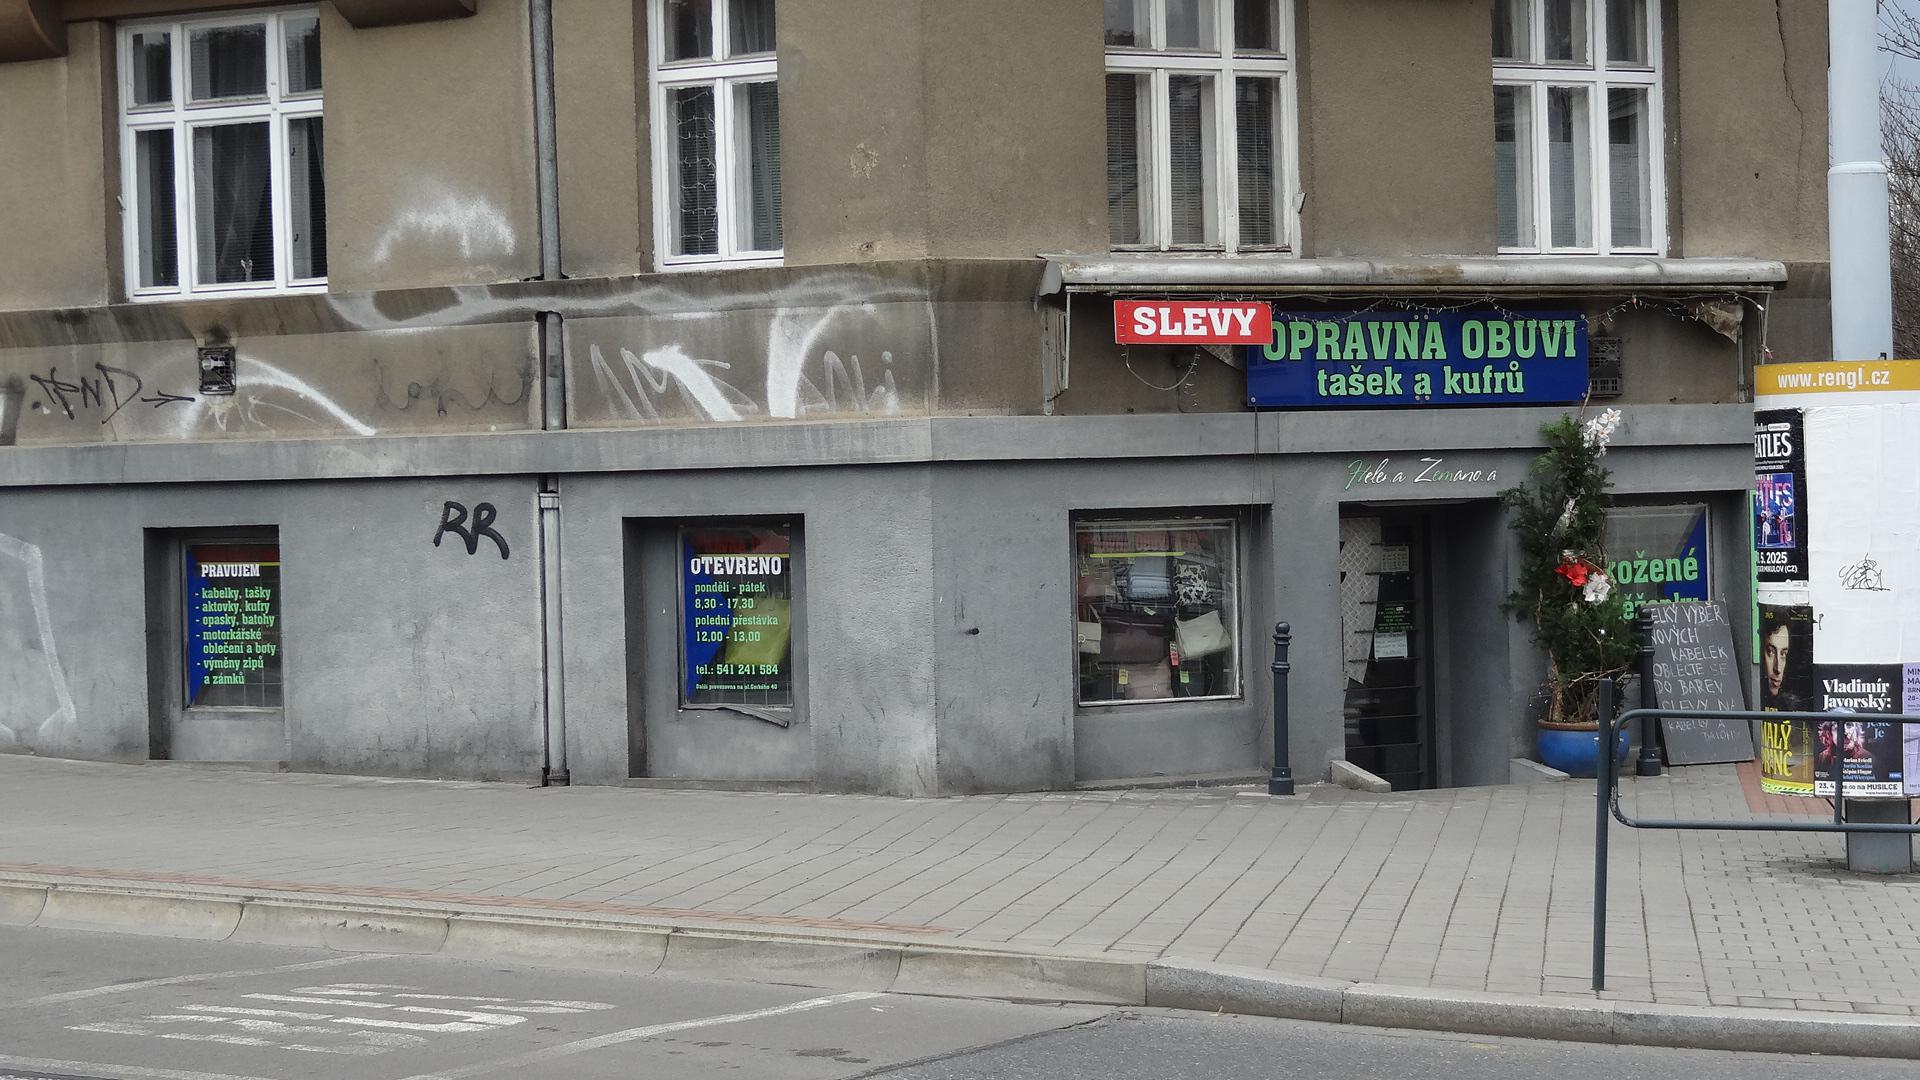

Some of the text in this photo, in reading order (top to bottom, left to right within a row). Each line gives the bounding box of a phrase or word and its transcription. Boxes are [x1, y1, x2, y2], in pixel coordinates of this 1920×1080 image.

[1133, 307, 1257, 337] SLEVY
[1263, 318, 1577, 361] OPRAVNA OBUVI
[1317, 360, 1525, 398] tašek a kufrů
[1777, 367, 1890, 389] www.rengl.cz
[1754, 432, 1792, 458] EATLES
[1345, 457, 1497, 490] Helea Zemanoa
[433, 501, 510, 560] RR
[201, 564, 260, 577] PRAVUJEM
[690, 557, 782, 575] OTEVRENO
[202, 587, 242, 601] kabelky,
[245, 586, 271, 600] tašky
[695, 581, 729, 594] pondělí
[739, 581, 766, 595] pátek
[202, 601, 242, 614] aktovky,
[245, 600, 270, 614] kufry
[695, 598, 716, 609] 8,30
[202, 614, 239, 627] opasky,
[242, 614, 275, 627] batohy
[695, 615, 778, 627] polední přestávka
[1651, 603, 1677, 624] ELKÝ
[203, 628, 262, 640] motorkářské
[696, 631, 723, 642] 12,00
[733, 631, 761, 642] 13,00
[203, 642, 276, 656] oblečení a boty
[1671, 645, 1728, 661] KABELEK
[203, 657, 240, 671] výměny
[243, 656, 264, 671] zipů
[696, 664, 778, 675] tel.: 541 241 584
[204, 672, 245, 684] a zámků
[1823, 677, 1890, 693] Vladimír
[1653, 679, 1723, 695] DO BAREV
[1823, 694, 1892, 711] Javorský:
